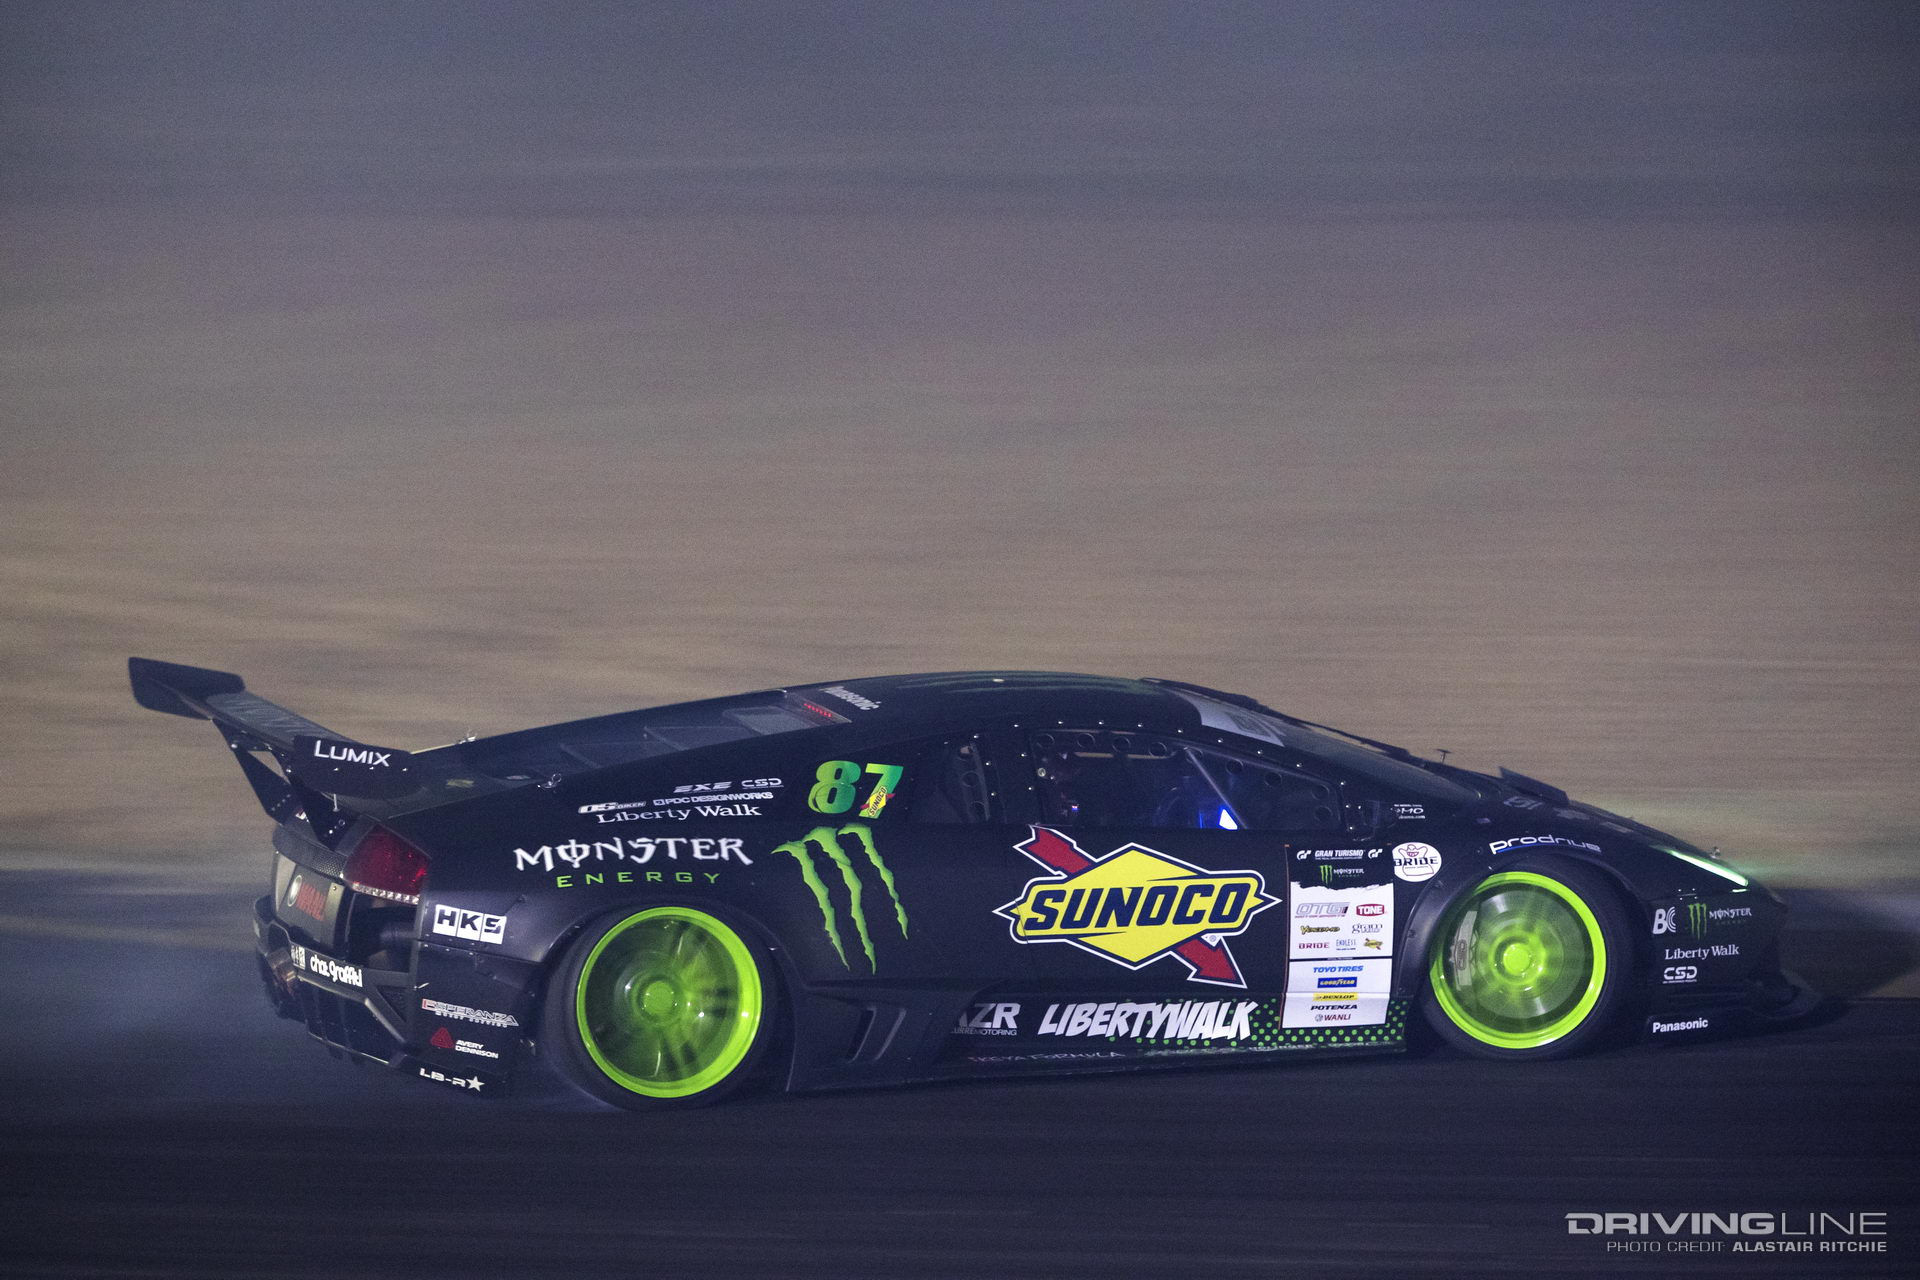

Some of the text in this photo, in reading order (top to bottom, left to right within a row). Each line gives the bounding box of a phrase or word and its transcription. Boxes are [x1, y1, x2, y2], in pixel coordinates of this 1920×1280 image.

[314, 740, 391, 767] LUMIX
[741, 778, 782, 787] CSD
[808, 760, 904, 819] 87
[691, 792, 774, 802] DESIGNWORKS
[869, 786, 887, 816] SUNOCO
[596, 804, 762, 823] Liberty Walk
[1488, 834, 1602, 855] prodrive
[513, 837, 753, 872] MONSTER
[1334, 849, 1364, 857] TURISMO
[1394, 856, 1438, 866] BRIDE
[556, 871, 720, 888] ENERGY
[1333, 868, 1364, 876] MONSTER
[1023, 883, 1251, 930] SUNOCO
[1358, 904, 1383, 915] TONE
[1709, 907, 1752, 920] MONSTER
[436, 908, 504, 935] HKS
[1298, 942, 1329, 950] BRIDE
[1665, 944, 1740, 960] Liberty Walk
[1664, 966, 1698, 980] CSD
[1653, 1017, 1709, 1033] Panasonic
[455, 1045, 499, 1059] DENNISON
[456, 1040, 484, 1049] AVERY
